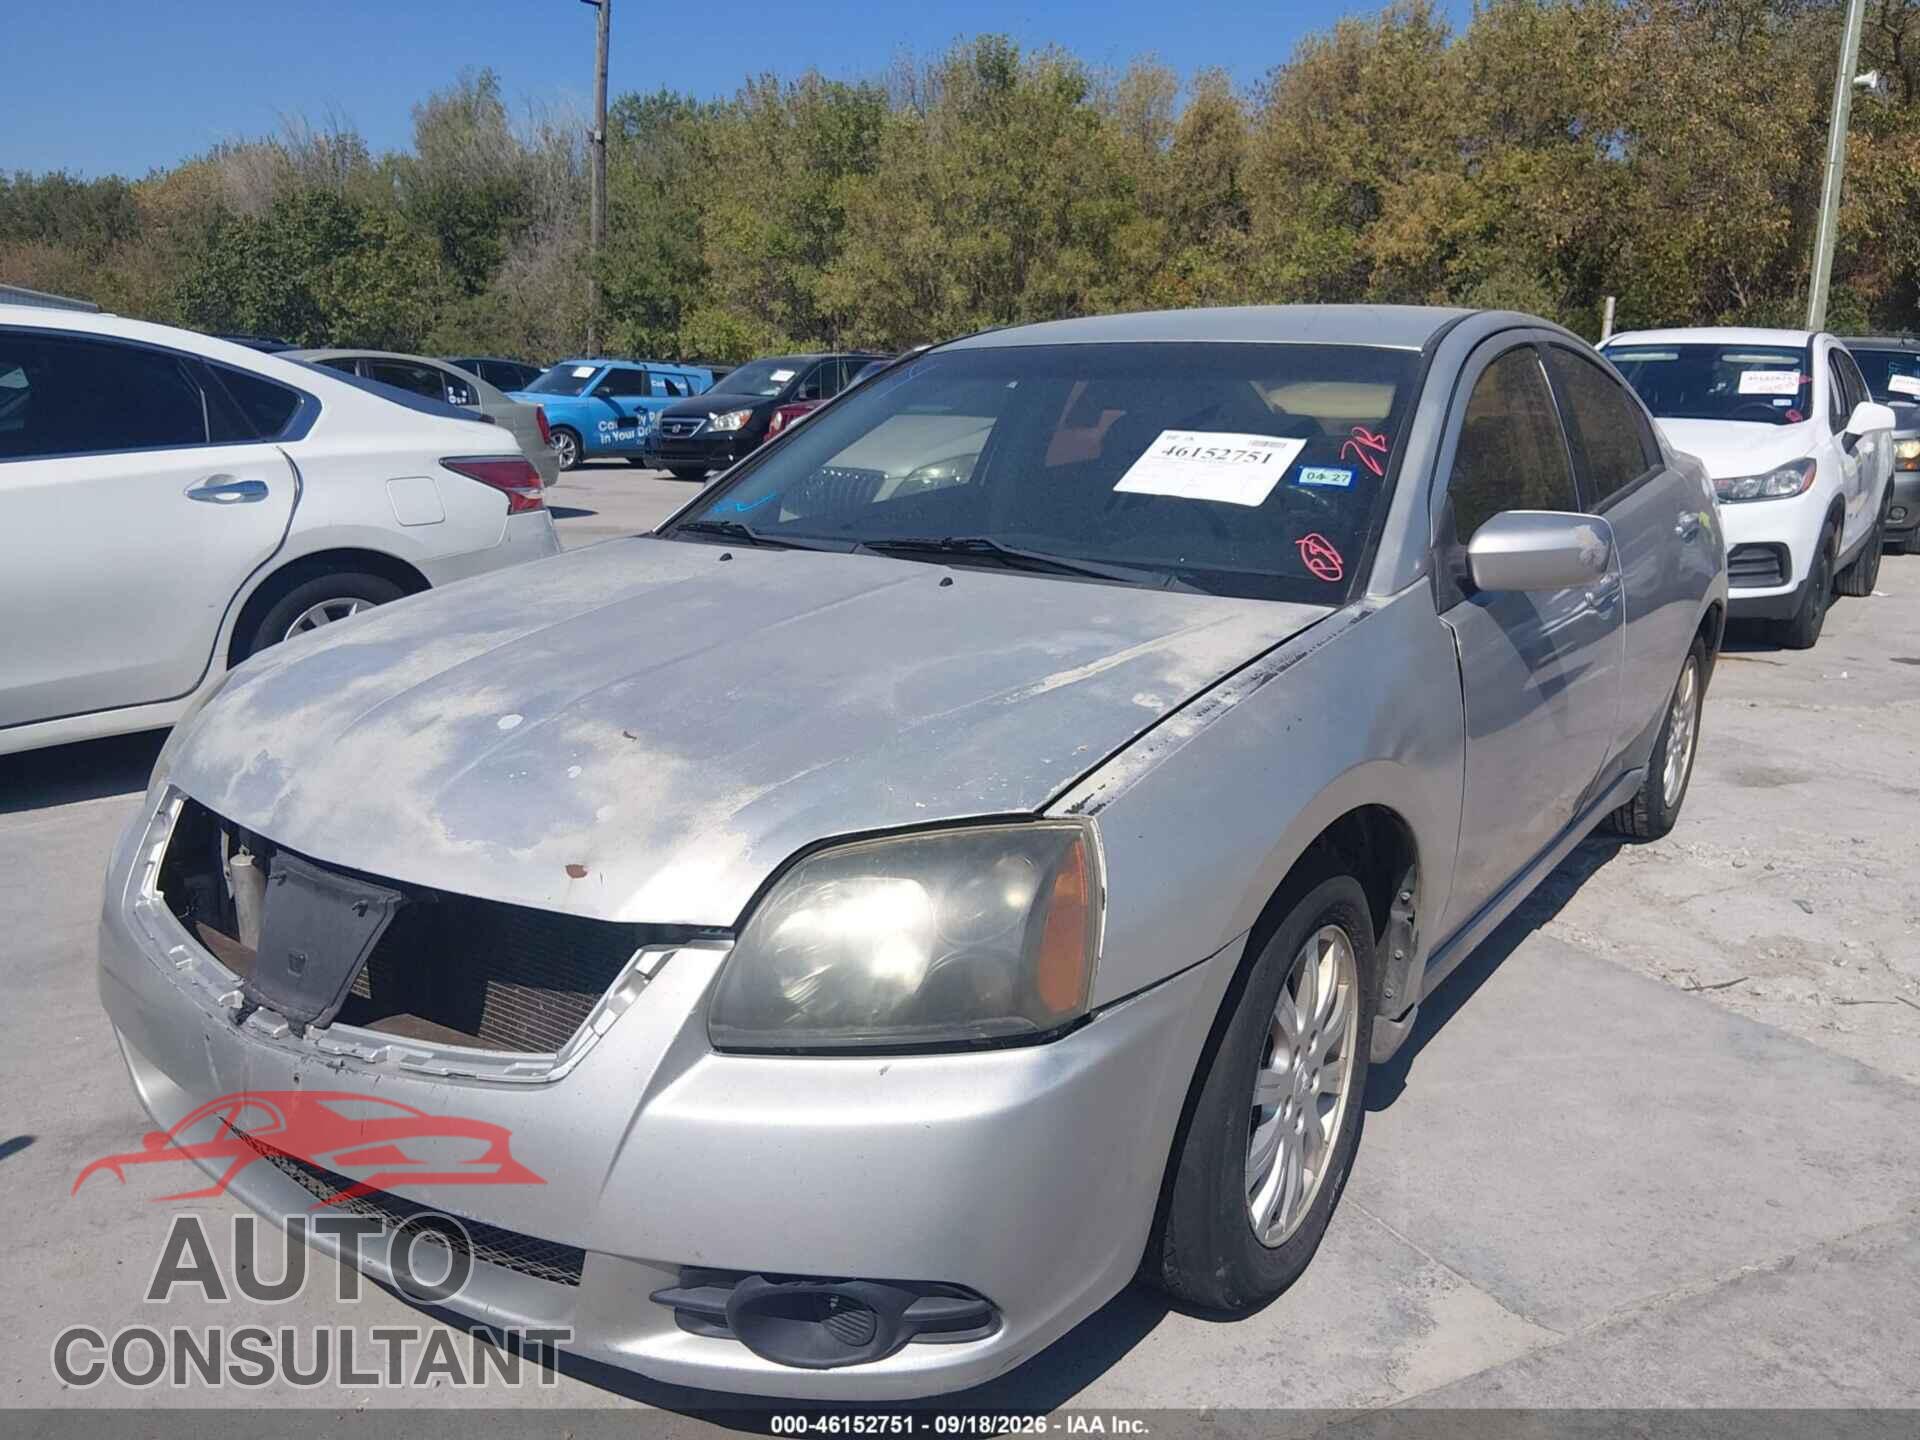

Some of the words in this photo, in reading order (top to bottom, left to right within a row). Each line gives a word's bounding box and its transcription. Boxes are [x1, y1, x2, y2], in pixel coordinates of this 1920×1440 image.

[612, 429, 635, 441] Your
[1161, 445, 1274, 464] 46152751
[1331, 473, 1350, 483] 27
